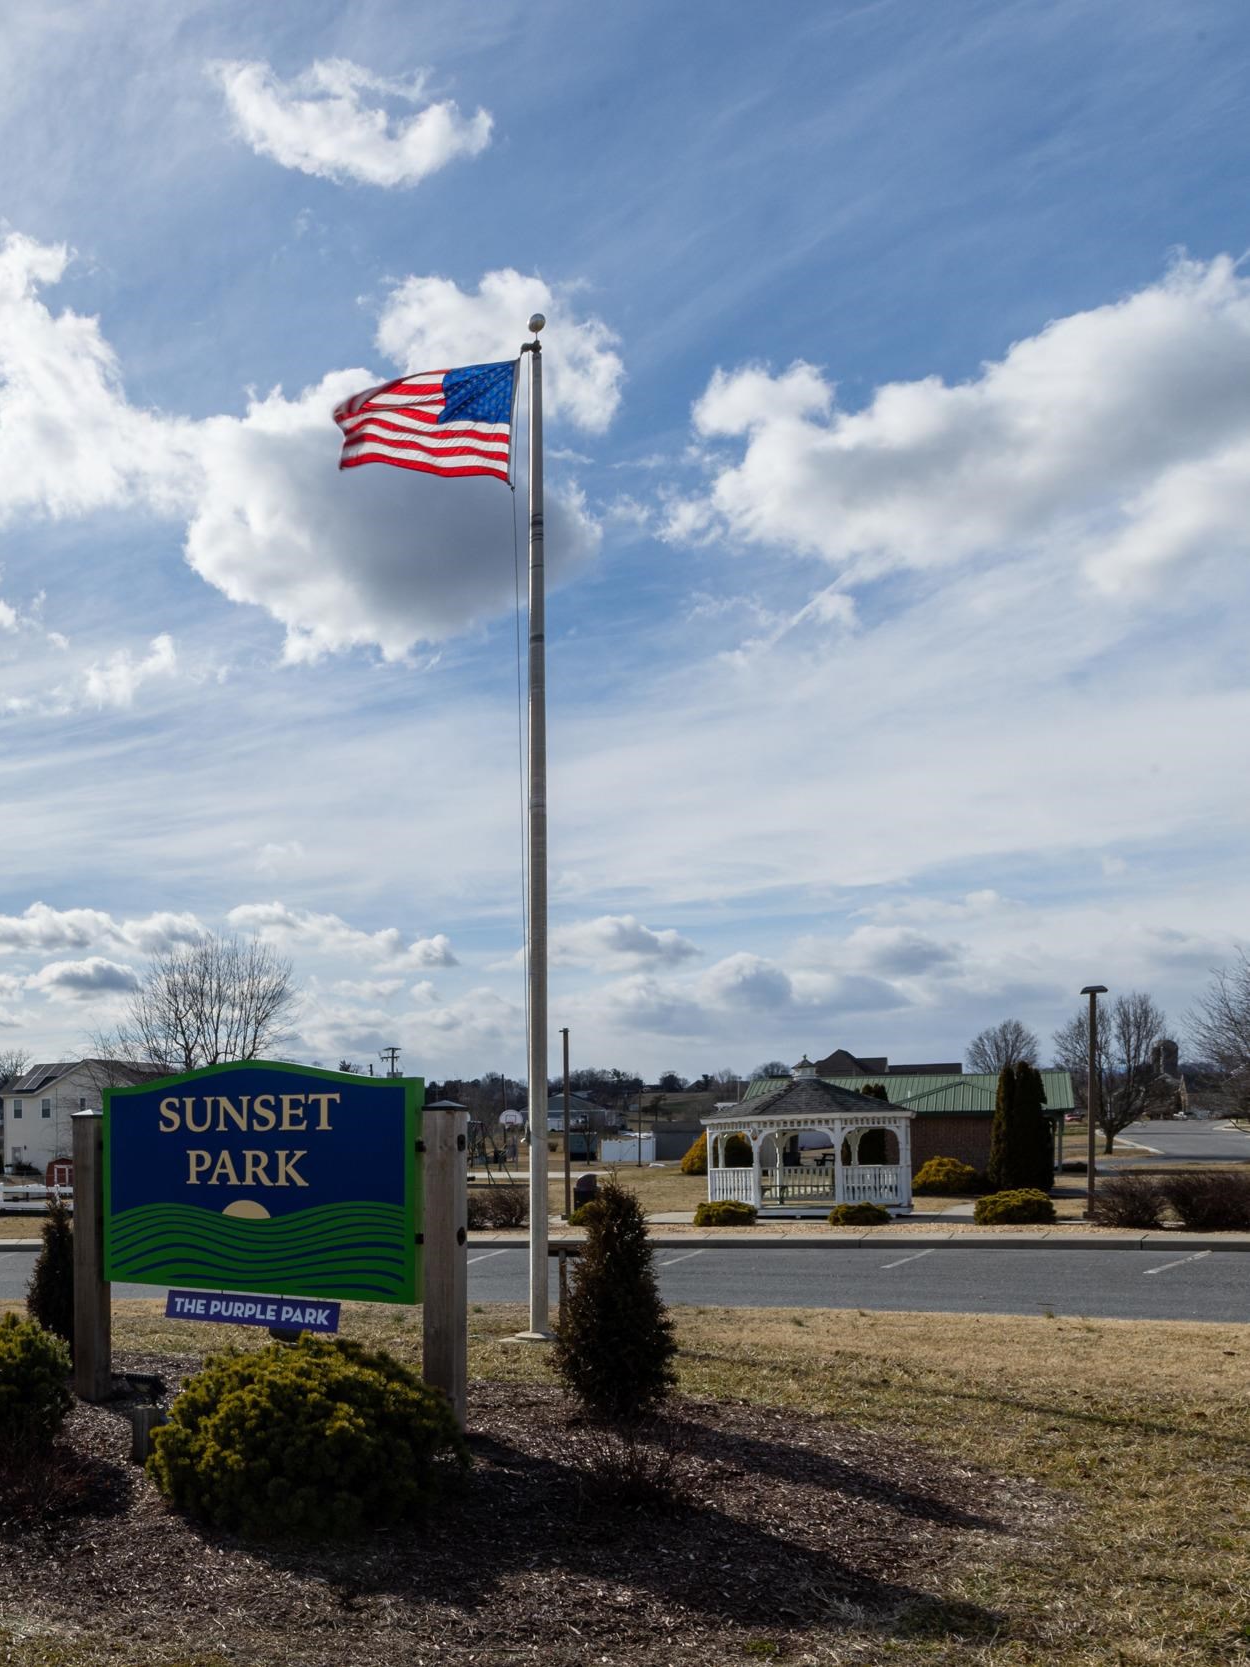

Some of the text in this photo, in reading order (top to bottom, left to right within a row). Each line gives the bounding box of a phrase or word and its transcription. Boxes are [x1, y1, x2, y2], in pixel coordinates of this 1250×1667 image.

[159, 1093, 340, 1133] SUNSET
[186, 1150, 309, 1187] PARK
[174, 1297, 329, 1326] THE PURPLE PARK
